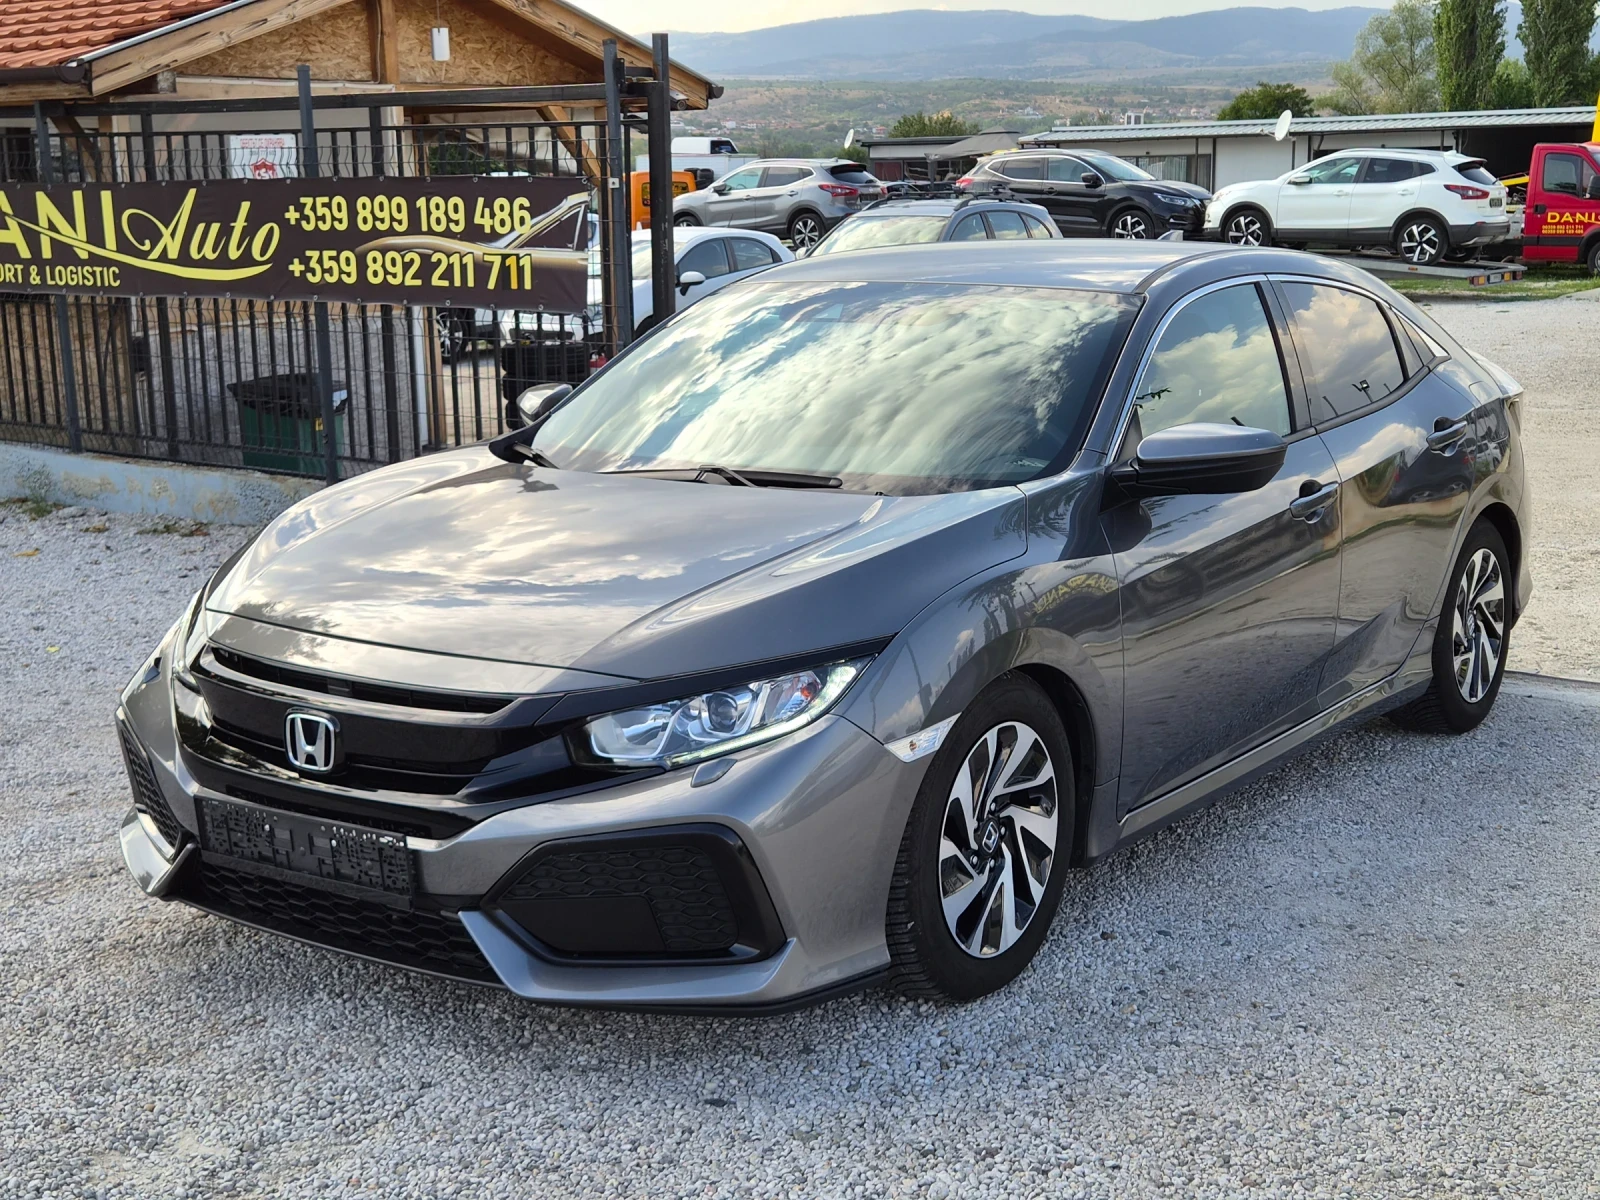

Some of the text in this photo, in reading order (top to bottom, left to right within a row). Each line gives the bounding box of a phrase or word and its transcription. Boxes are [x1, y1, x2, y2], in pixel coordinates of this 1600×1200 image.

[0, 188, 281, 262] ANI Auto
[284, 194, 532, 235] +359 899 189 486
[1547, 212, 1596, 223] DANI
[29, 265, 42, 285] &
[45, 265, 121, 287] LOGISTIC
[288, 250, 532, 290] +359 892 211 711
